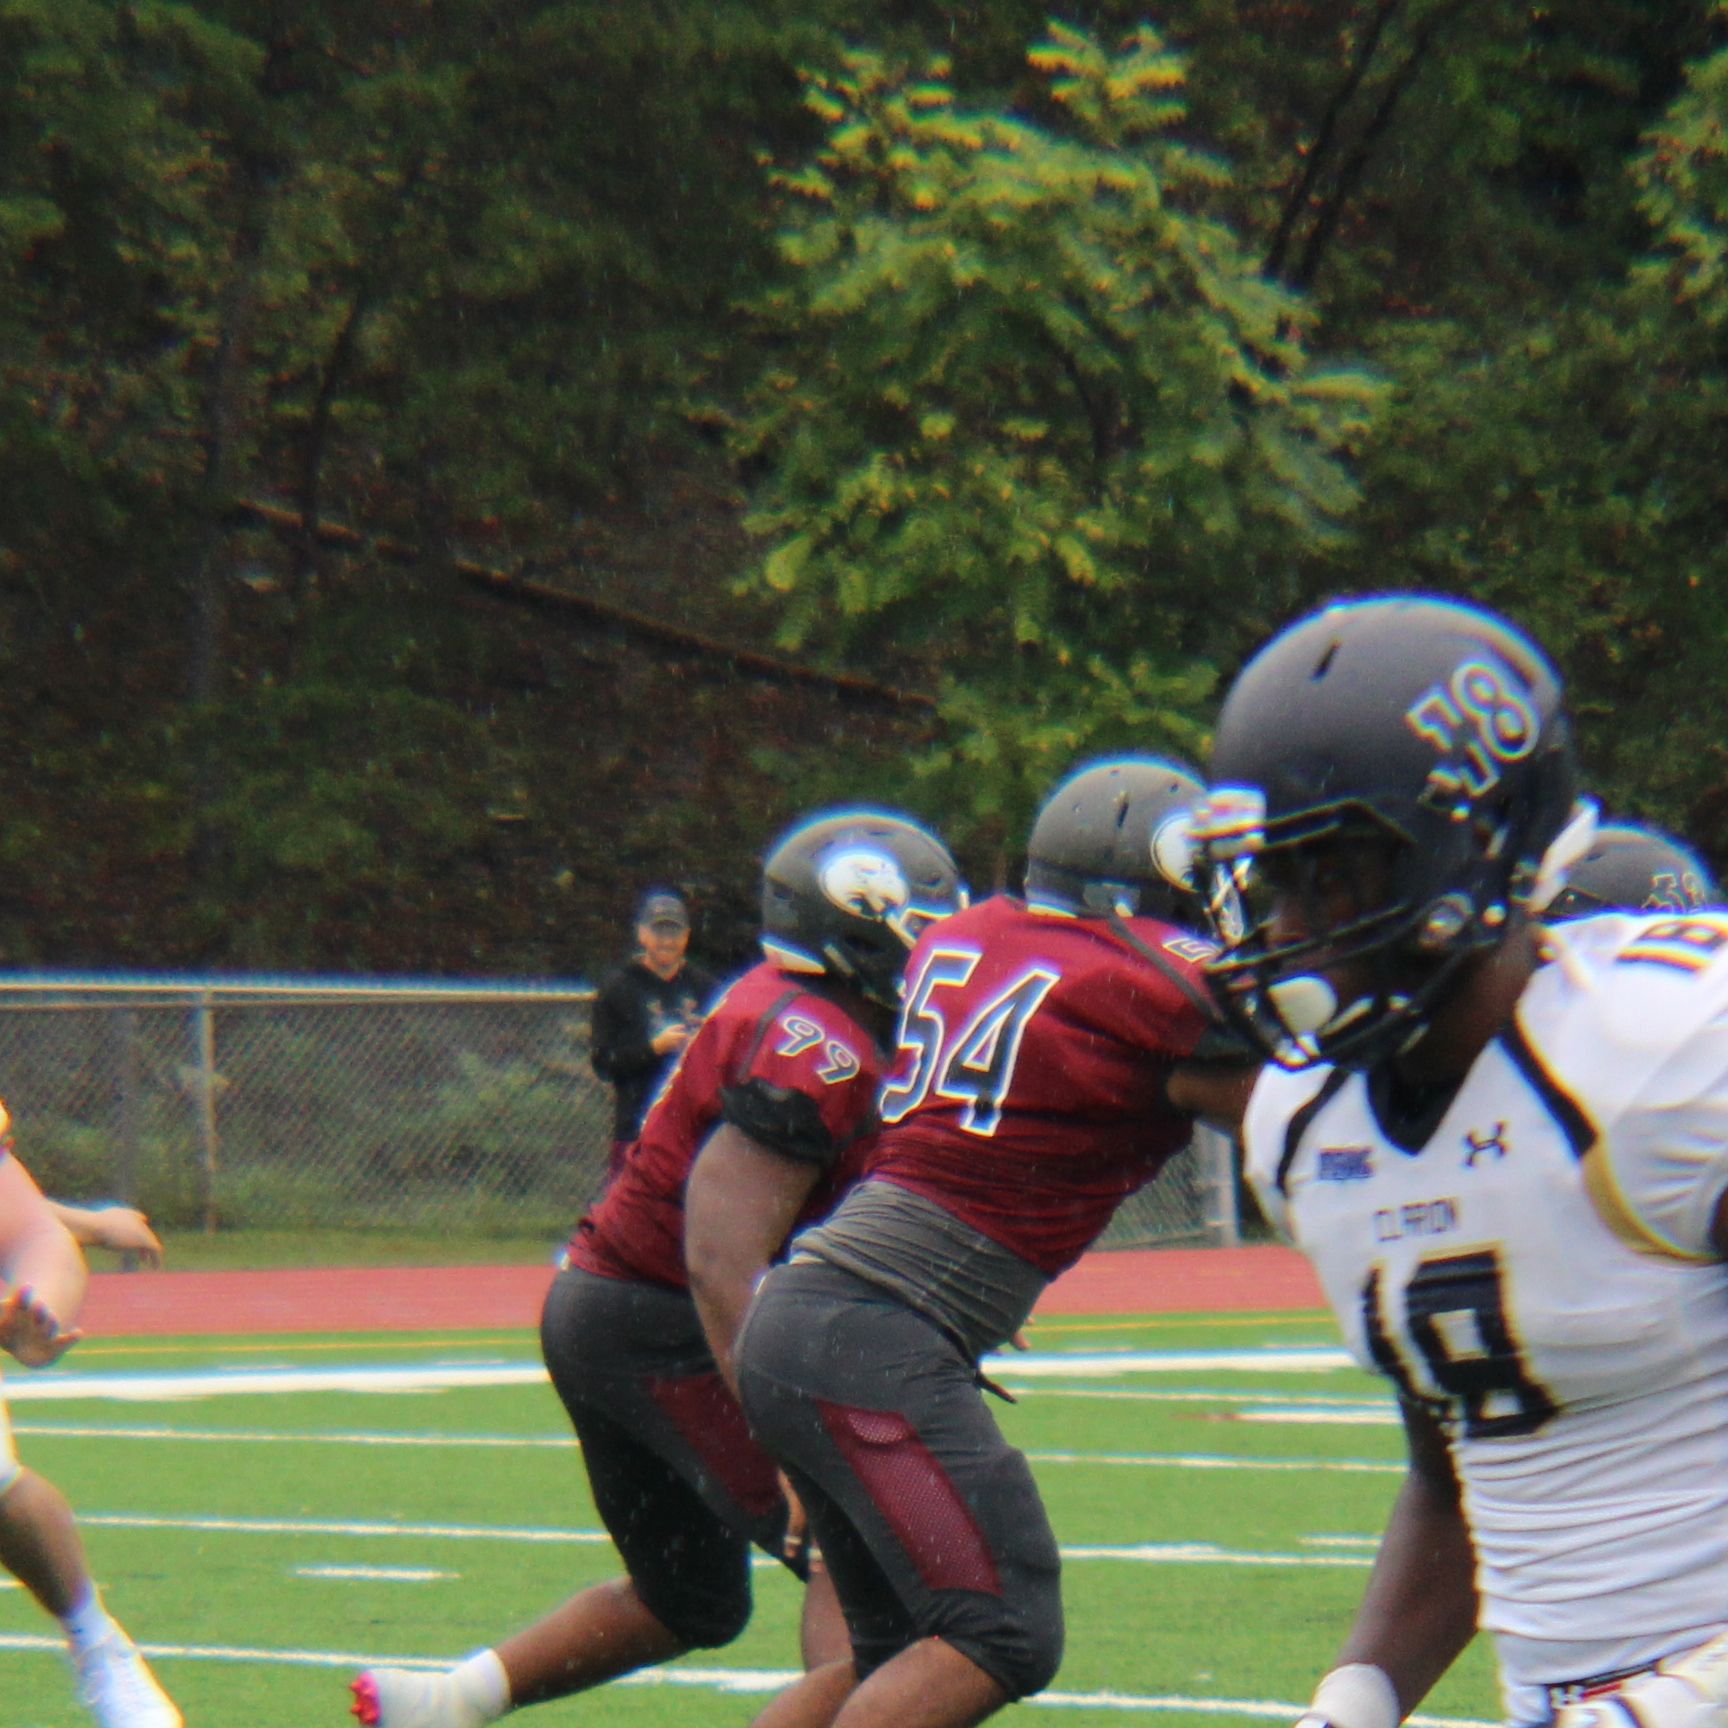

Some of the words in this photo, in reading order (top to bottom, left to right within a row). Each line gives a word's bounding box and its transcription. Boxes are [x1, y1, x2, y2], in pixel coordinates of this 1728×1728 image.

[776, 1015, 860, 1085] 99
[879, 949, 1062, 1138] 54
[1362, 1241, 1562, 1440] 18
